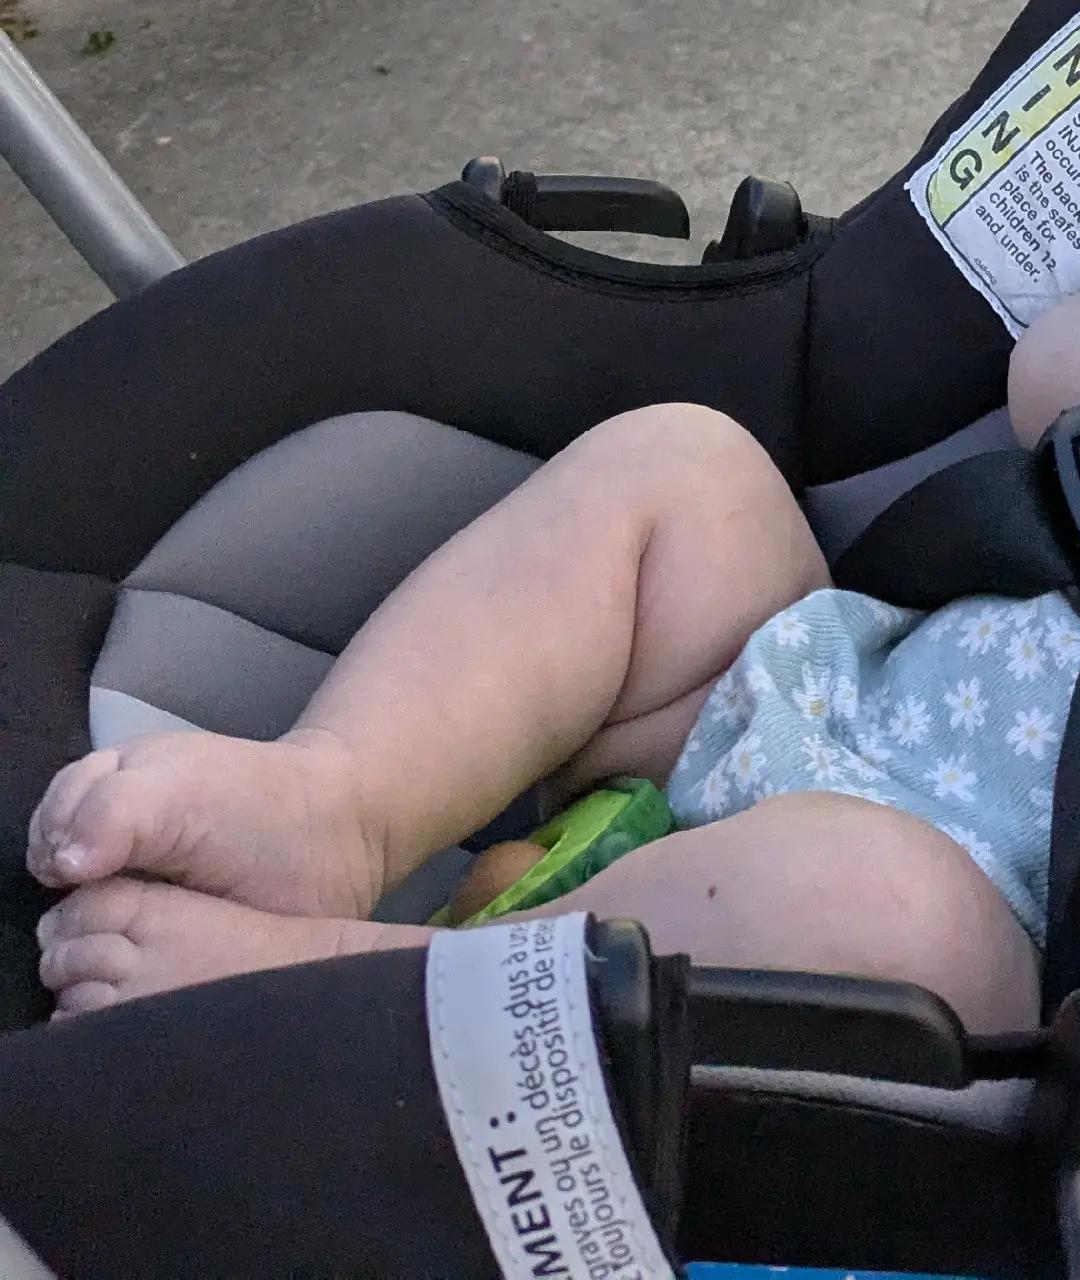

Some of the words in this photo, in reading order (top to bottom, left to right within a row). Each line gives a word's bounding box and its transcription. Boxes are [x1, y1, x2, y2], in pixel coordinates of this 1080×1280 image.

[1014, 163, 1030, 183] is
[1028, 180, 1050, 209] the
[1029, 150, 1053, 184] The
[989, 192, 1041, 252] children
[1041, 250, 1057, 273] 12
[999, 179, 1038, 221] place
[1035, 219, 1057, 244] for
[975, 205, 1005, 236] and
[1000, 234, 1041, 284] under.
[501, 951, 528, 966] à
[529, 957, 556, 991] de
[503, 969, 530, 1019] dus
[510, 1025, 550, 1110] décès
[530, 998, 585, 1128] dispositif
[536, 1118, 562, 1154] un
[568, 1134, 594, 1161] le
[549, 1157, 577, 1192] ou
[488, 1146, 571, 1280] MENT
[580, 1162, 635, 1272] toujours
